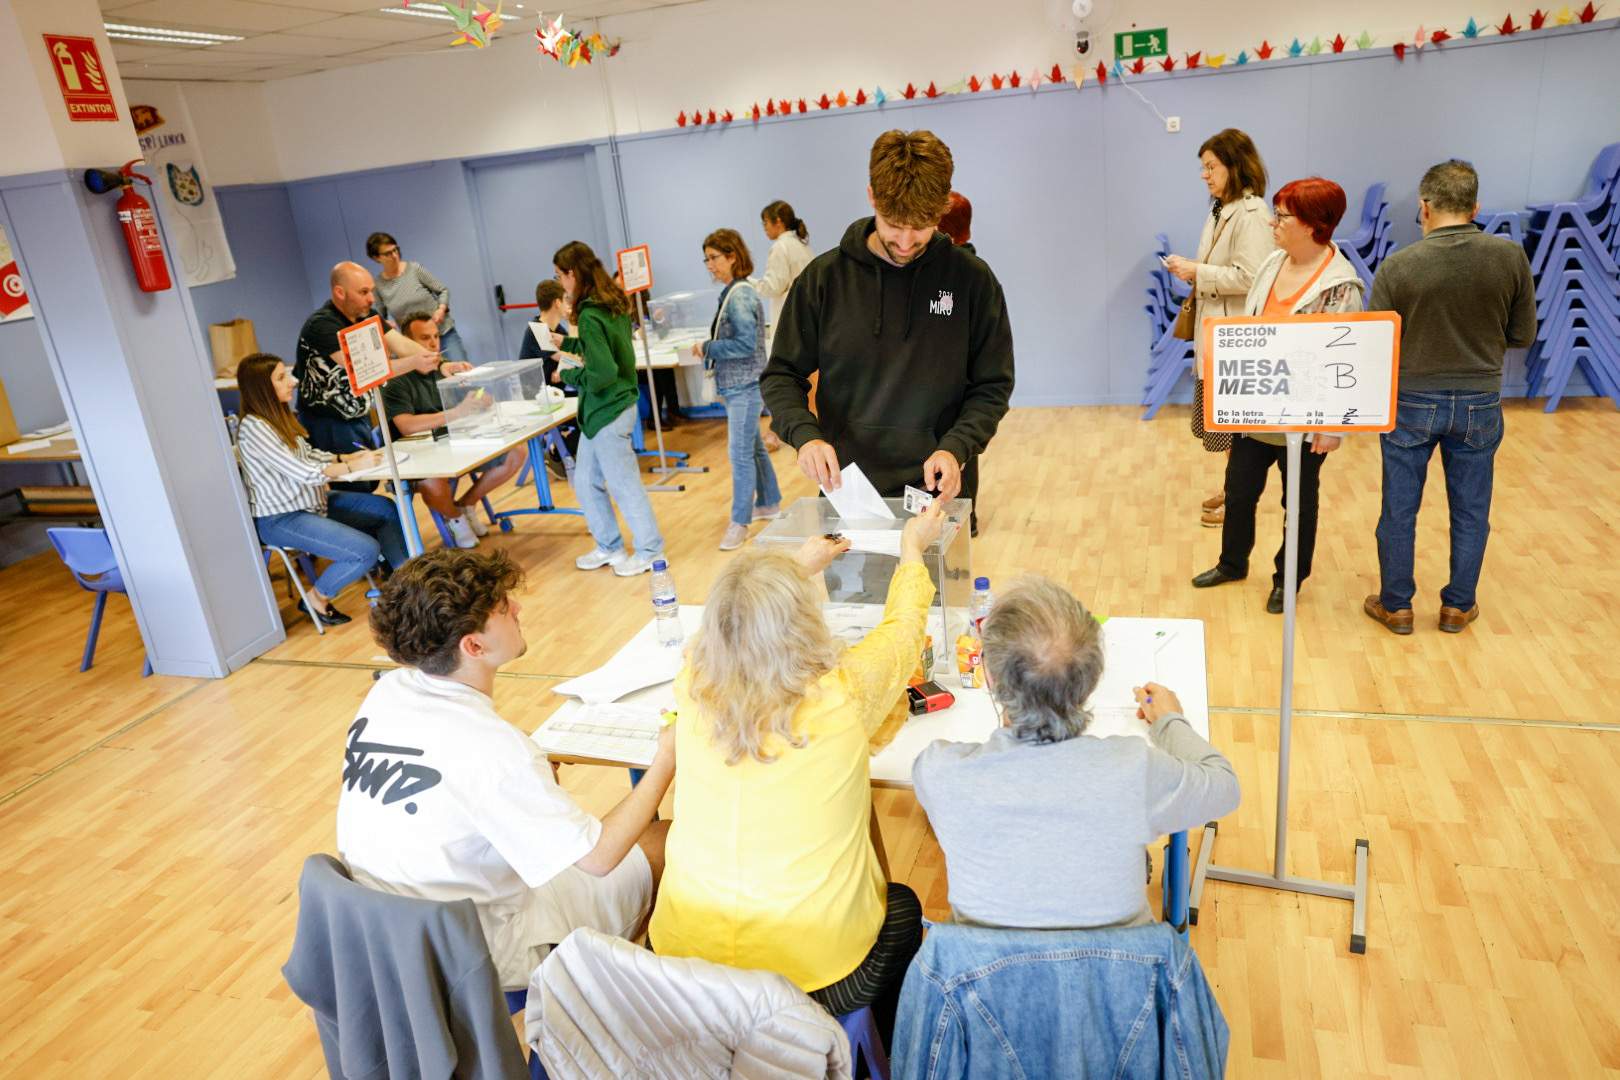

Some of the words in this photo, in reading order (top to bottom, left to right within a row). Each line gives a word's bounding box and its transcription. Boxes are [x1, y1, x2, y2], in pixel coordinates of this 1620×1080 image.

[70, 103, 113, 113] EXTINTOR
[1218, 325, 1277, 337] SECCIÓN
[1325, 326, 1357, 348] 2
[1218, 336, 1268, 348] SECCIÓ
[1218, 359, 1291, 376] MESA
[1325, 363, 1357, 389] B
[1218, 378, 1290, 395] MESA
